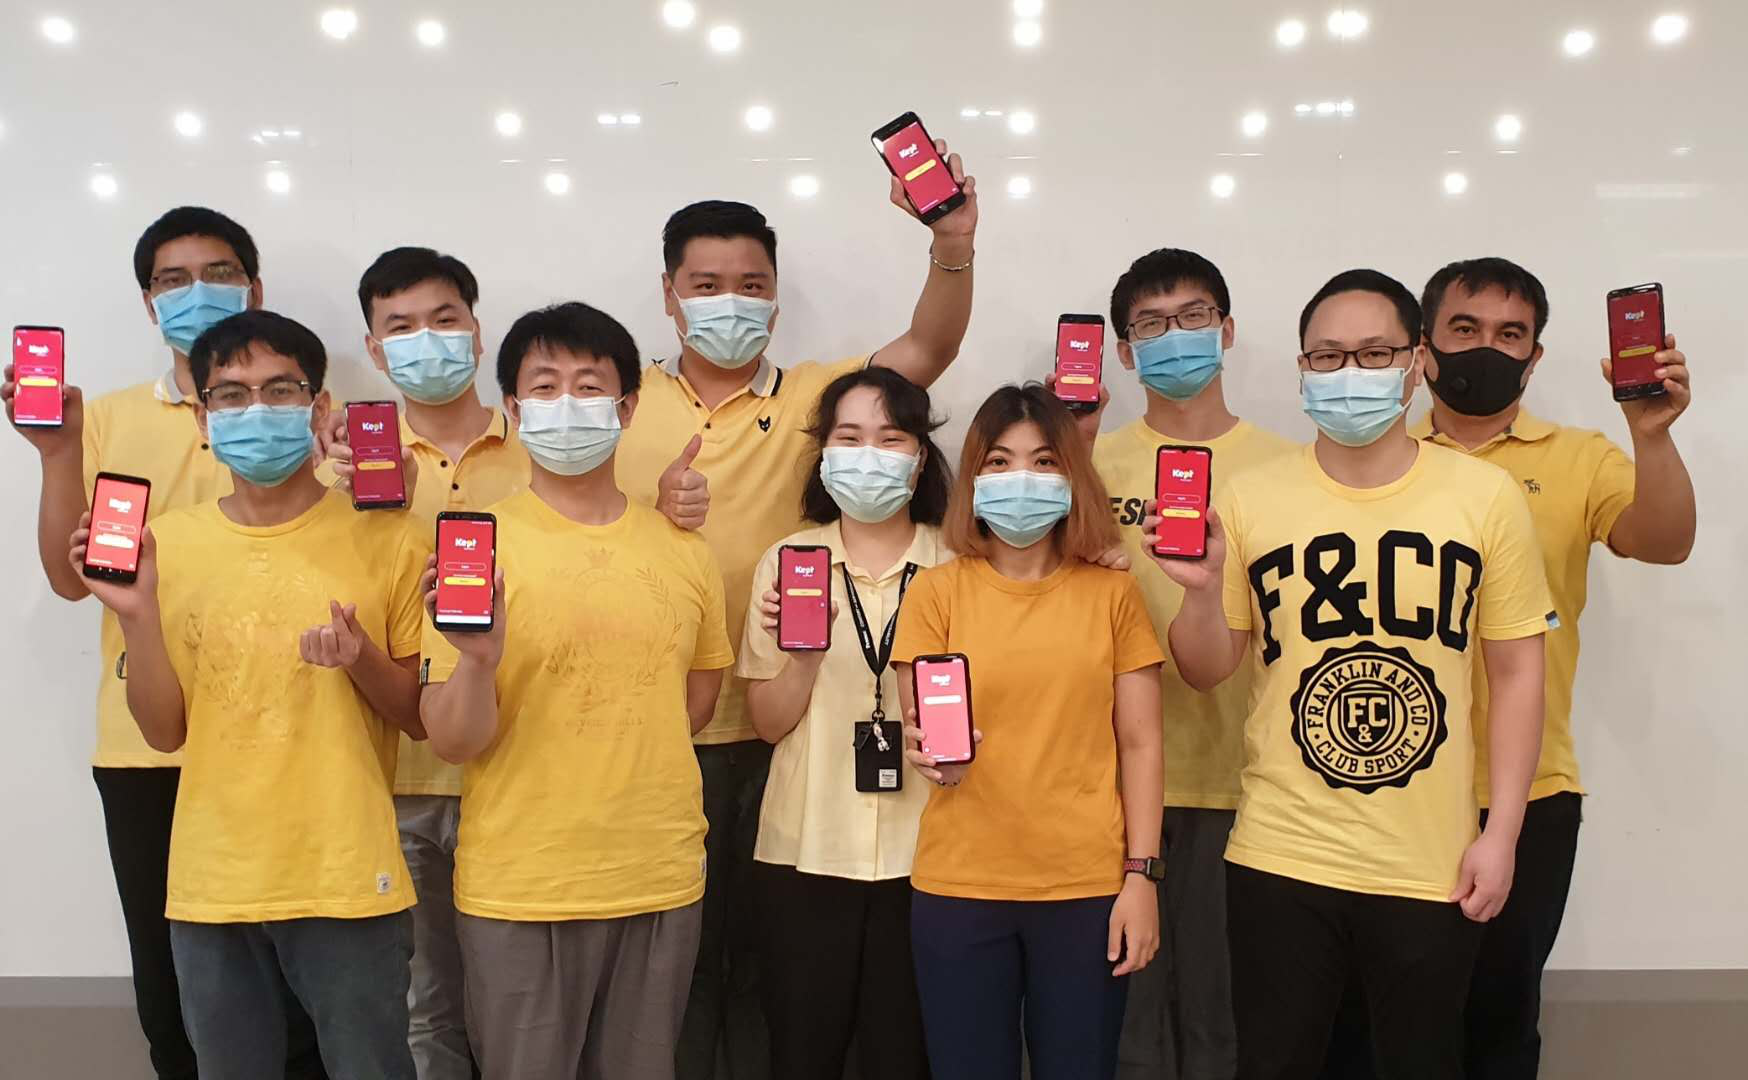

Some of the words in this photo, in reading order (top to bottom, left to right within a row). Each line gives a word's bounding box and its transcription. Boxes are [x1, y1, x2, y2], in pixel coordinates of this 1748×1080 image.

[899, 144, 917, 158] Kept
[1625, 310, 1645, 321] Kept
[1070, 341, 1089, 350] Kept
[362, 421, 383, 432] Kept
[1172, 469, 1194, 479] Kept
[455, 538, 477, 548] Kept
[795, 566, 815, 577] Kept
[1248, 530, 1483, 667] F&CO
[1307, 662, 1383, 728] FRANKLIN
[1385, 668, 1422, 702] AND
[1410, 704, 1428, 726] CO
[1347, 696, 1388, 728] FC
[1358, 723, 1373, 743] &
[1316, 740, 1359, 774] CLUB
[1364, 738, 1417, 774] SPORT
